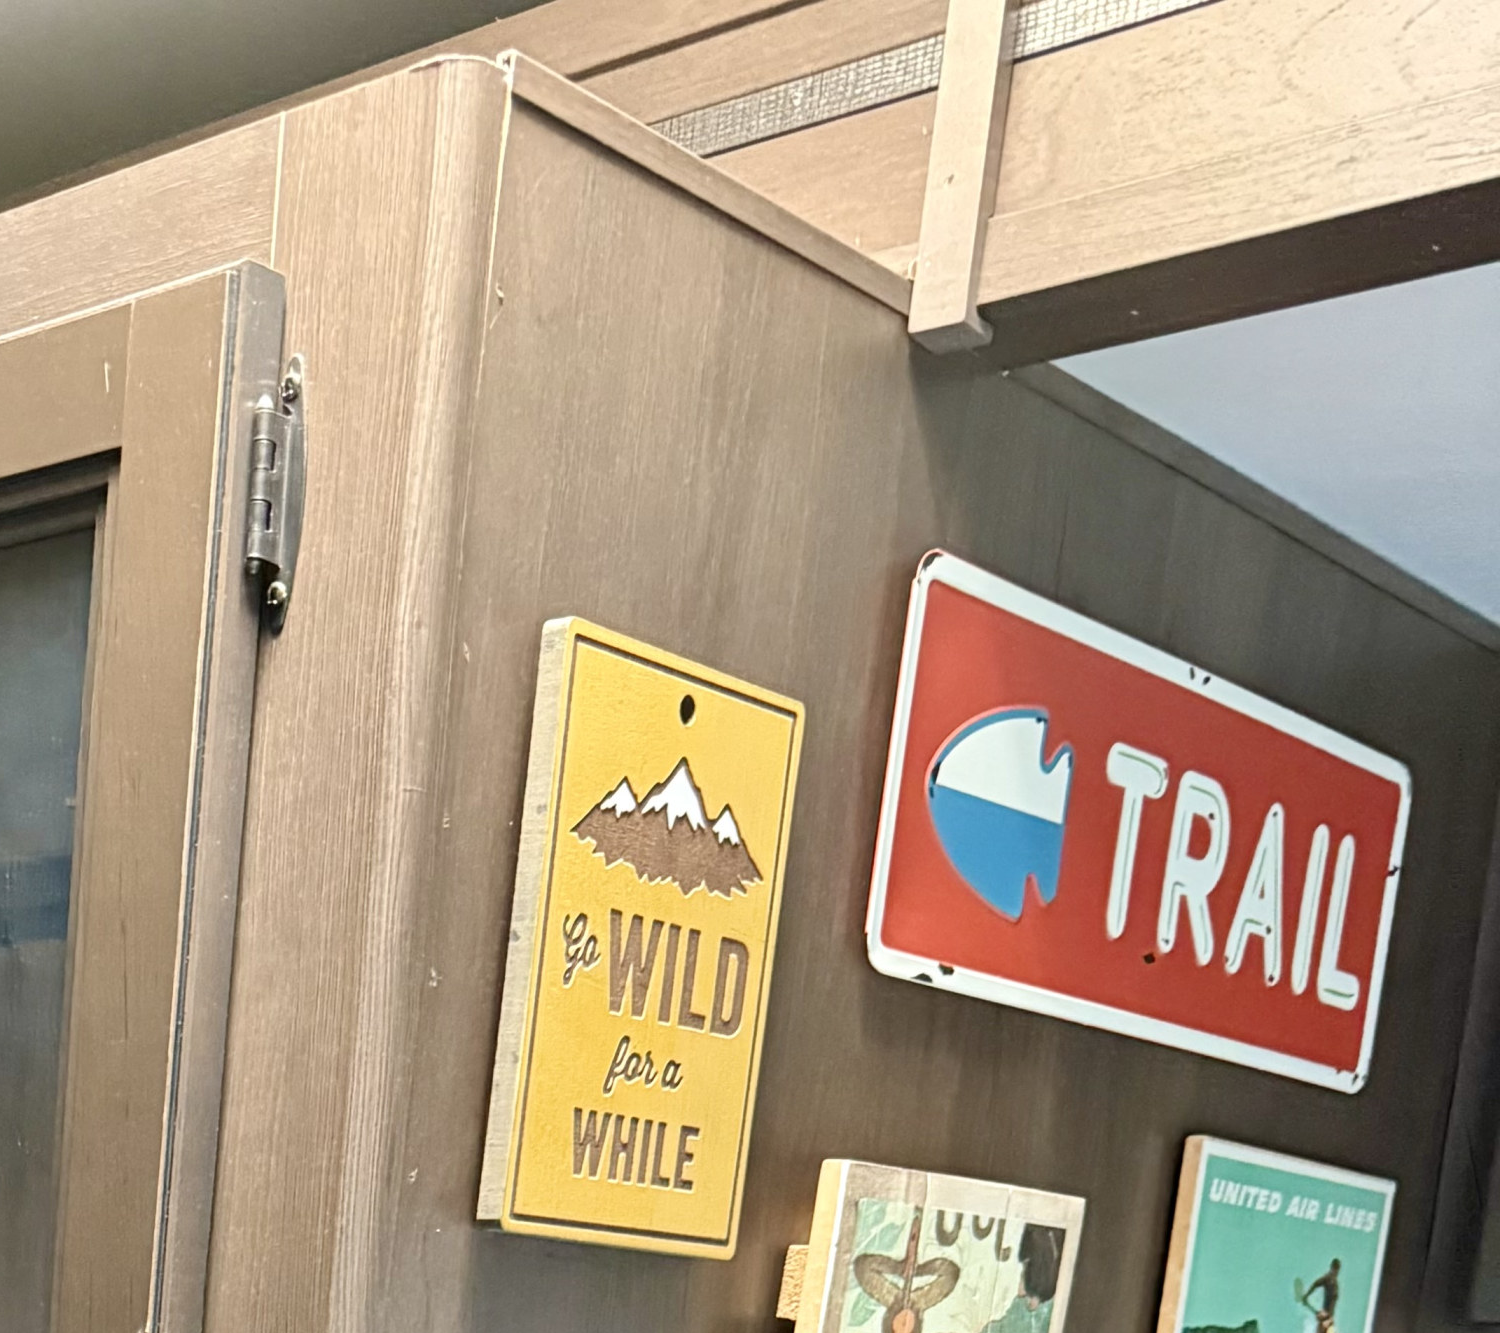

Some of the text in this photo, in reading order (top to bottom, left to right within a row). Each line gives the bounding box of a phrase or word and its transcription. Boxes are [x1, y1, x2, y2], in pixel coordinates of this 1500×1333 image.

[1106, 742, 1360, 1011] TRAIL
[563, 908, 749, 1037] Go WILD
[602, 1035, 684, 1096] for a
[573, 1107, 700, 1193] WHILE
[1209, 1178, 1378, 1232] UNITED AIR LINES
